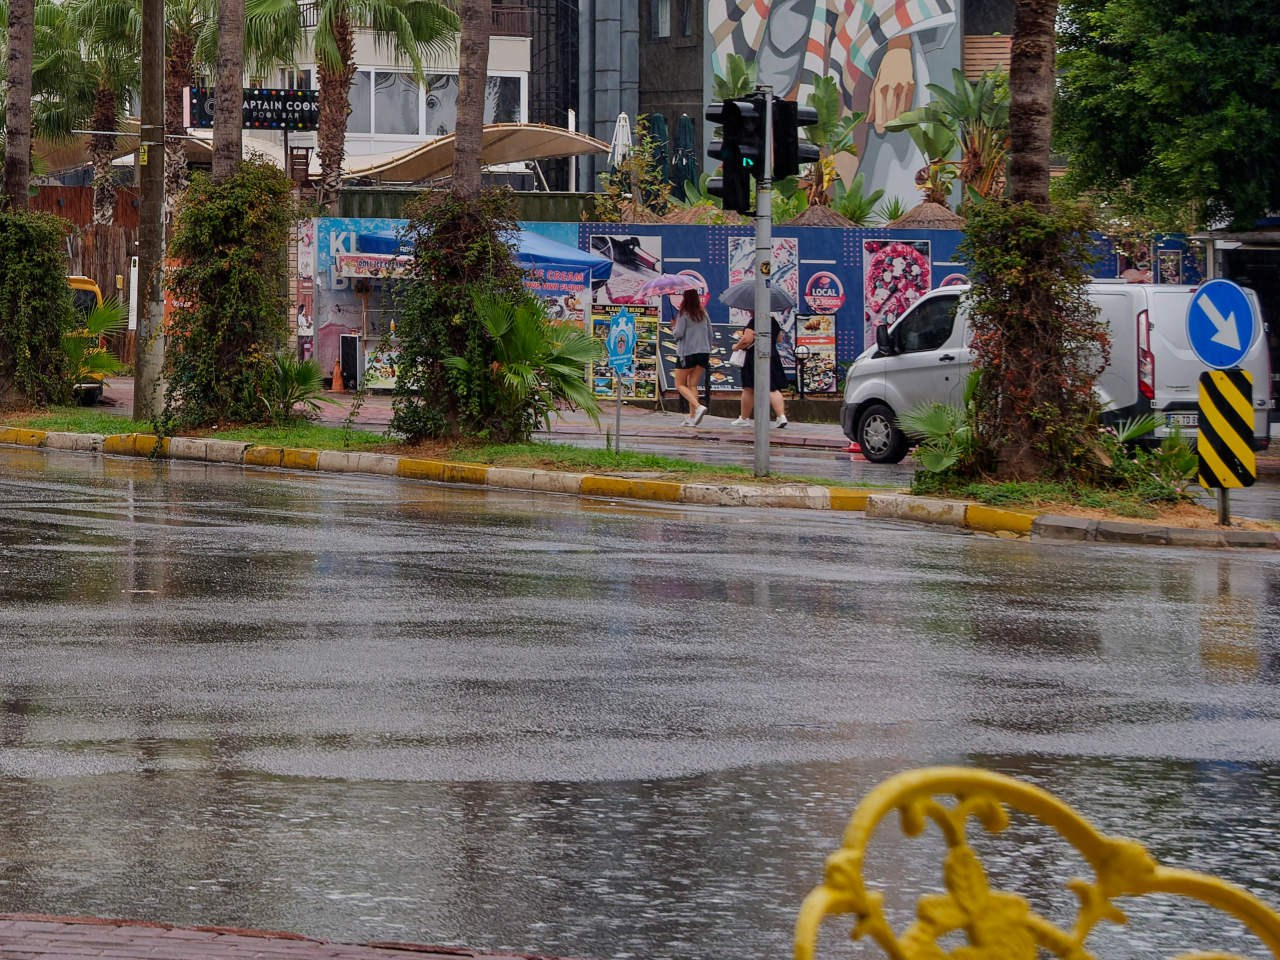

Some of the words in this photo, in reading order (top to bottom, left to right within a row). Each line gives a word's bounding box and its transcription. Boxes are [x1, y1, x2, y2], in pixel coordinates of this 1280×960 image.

[243, 100, 282, 110] APTAIN
[252, 111, 277, 119] POOL
[547, 270, 584, 282] CREAM
[811, 288, 838, 297] LOCAL
